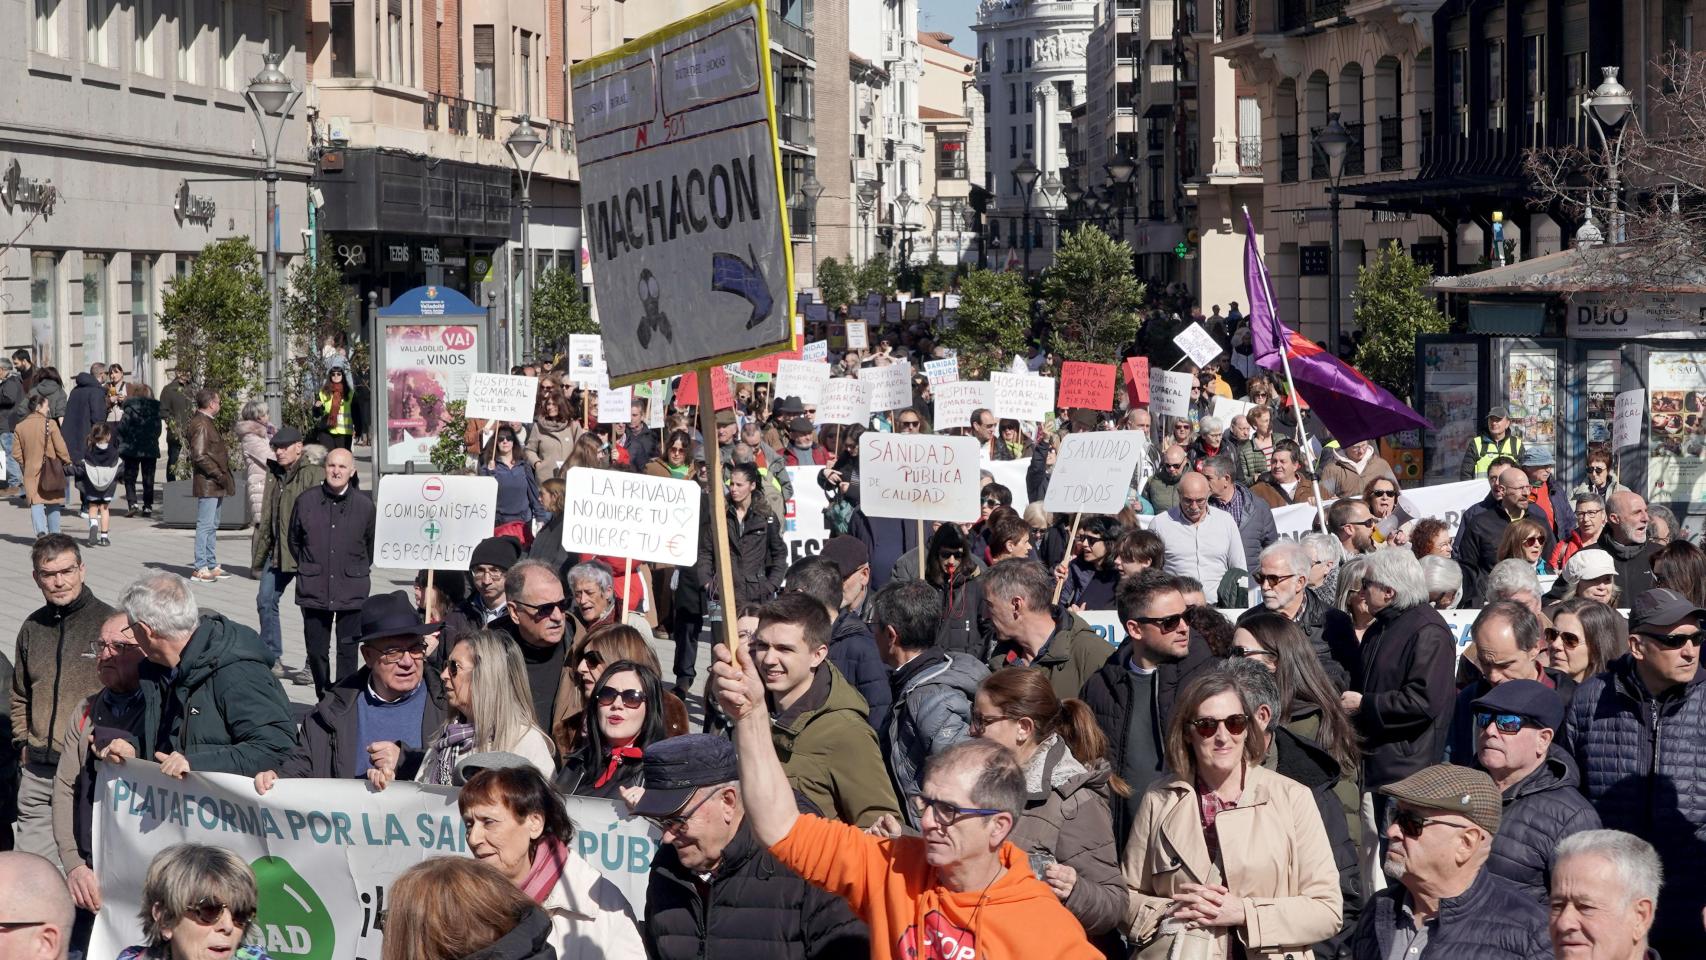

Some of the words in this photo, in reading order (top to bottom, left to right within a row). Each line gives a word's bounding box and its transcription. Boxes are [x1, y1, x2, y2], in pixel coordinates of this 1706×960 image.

[586, 154, 761, 262] MACHACON
[445, 333, 470, 346] VA!
[427, 354, 466, 365] VINOS
[1063, 364, 1107, 378] HOSPITAL
[474, 375, 530, 387] HOSPITAL
[993, 374, 1047, 389] HOSPITAL
[473, 386, 528, 397] COMARCAL
[993, 388, 1049, 401] COMARCAL
[869, 440, 955, 465] SANIDAD
[1063, 440, 1131, 460] SANIDAD
[591, 475, 615, 496] LA
[622, 480, 686, 504] PRIVADA
[881, 488, 945, 504] CALIDAD
[1063, 483, 1113, 503] TODOS
[384, 502, 488, 520] COMISIONISTAS
[573, 499, 593, 517] NO
[597, 501, 644, 523] QUIERE
[650, 507, 668, 525] TU
[571, 523, 630, 550] QUIERE
[638, 532, 661, 553] TU
[665, 533, 686, 557] €
[381, 542, 474, 561] ESPECIALIST
[114, 779, 284, 840] PLATAFORMA
[285, 808, 356, 846] POR
[361, 812, 411, 847] LA
